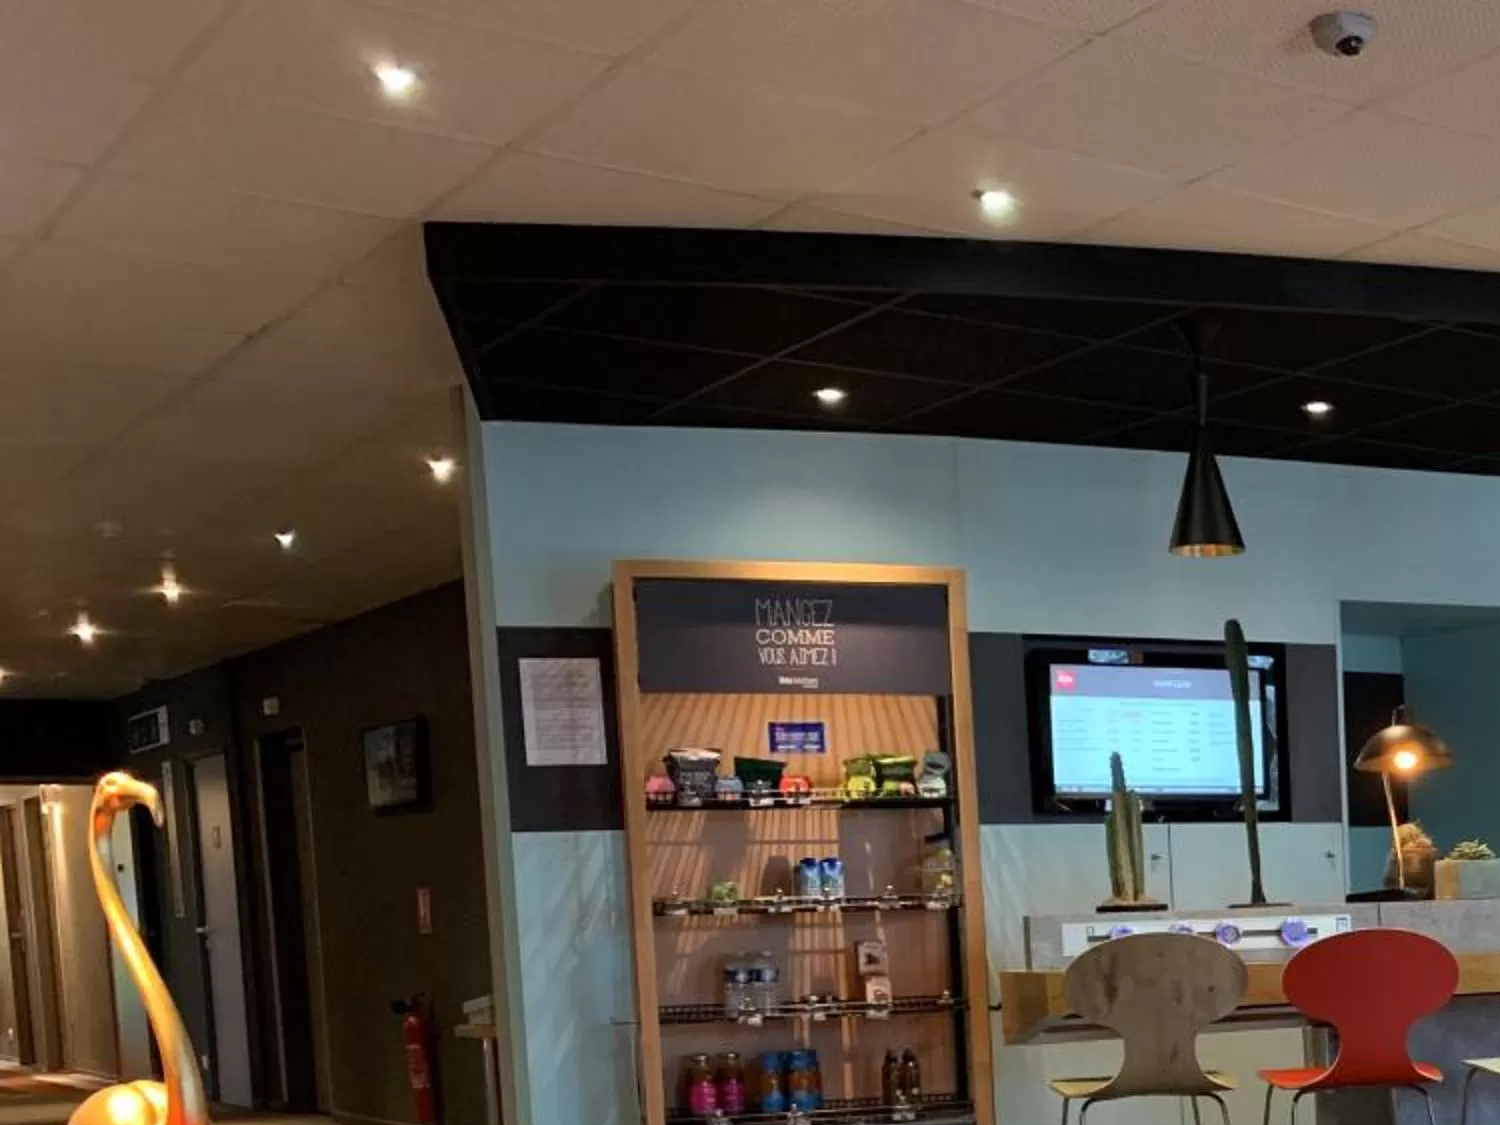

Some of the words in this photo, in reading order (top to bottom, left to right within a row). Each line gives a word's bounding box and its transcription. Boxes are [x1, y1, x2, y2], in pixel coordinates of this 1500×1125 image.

[755, 598, 835, 627] MANGEZ
[755, 629, 836, 645] COMME
[758, 647, 787, 665] VOUS
